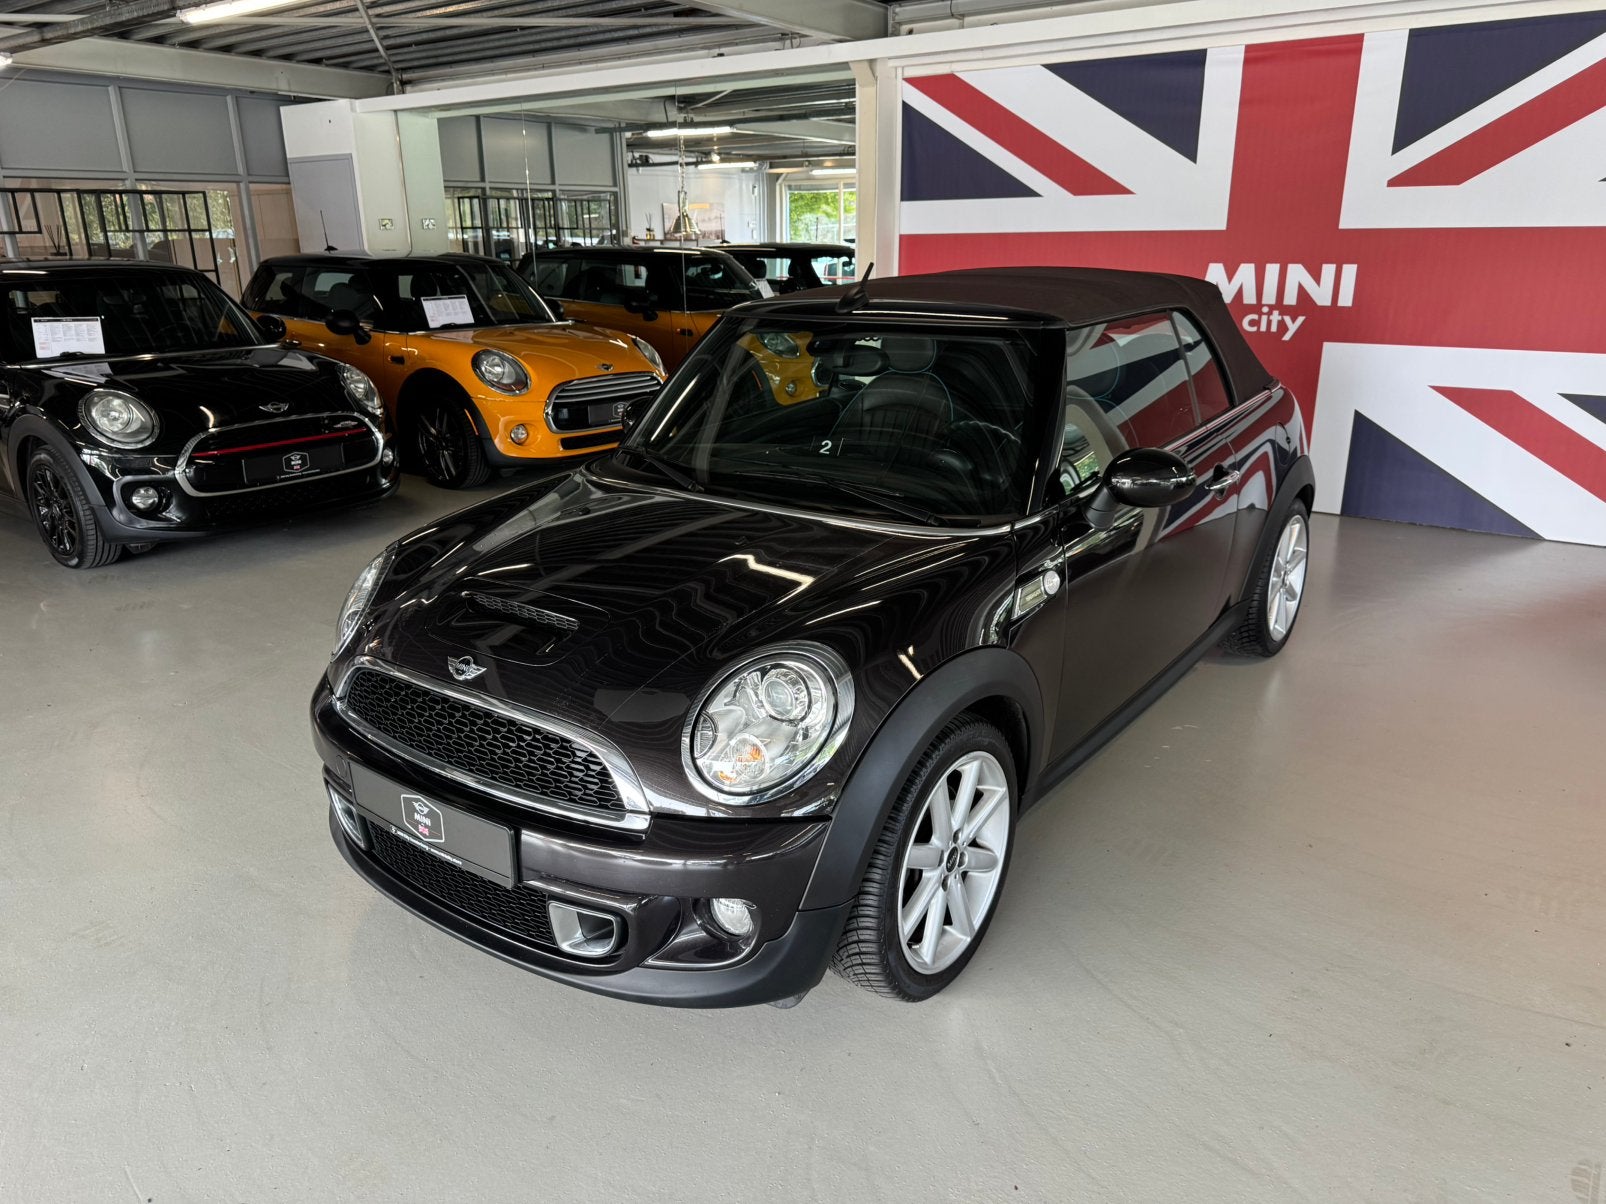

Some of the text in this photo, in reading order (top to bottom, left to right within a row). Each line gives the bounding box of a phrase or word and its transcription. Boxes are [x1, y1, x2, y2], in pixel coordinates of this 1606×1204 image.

[1204, 263, 1358, 307] MINI
[1242, 306, 1306, 341] city
[819, 440, 832, 454] 2
[414, 812, 431, 826] MINI
